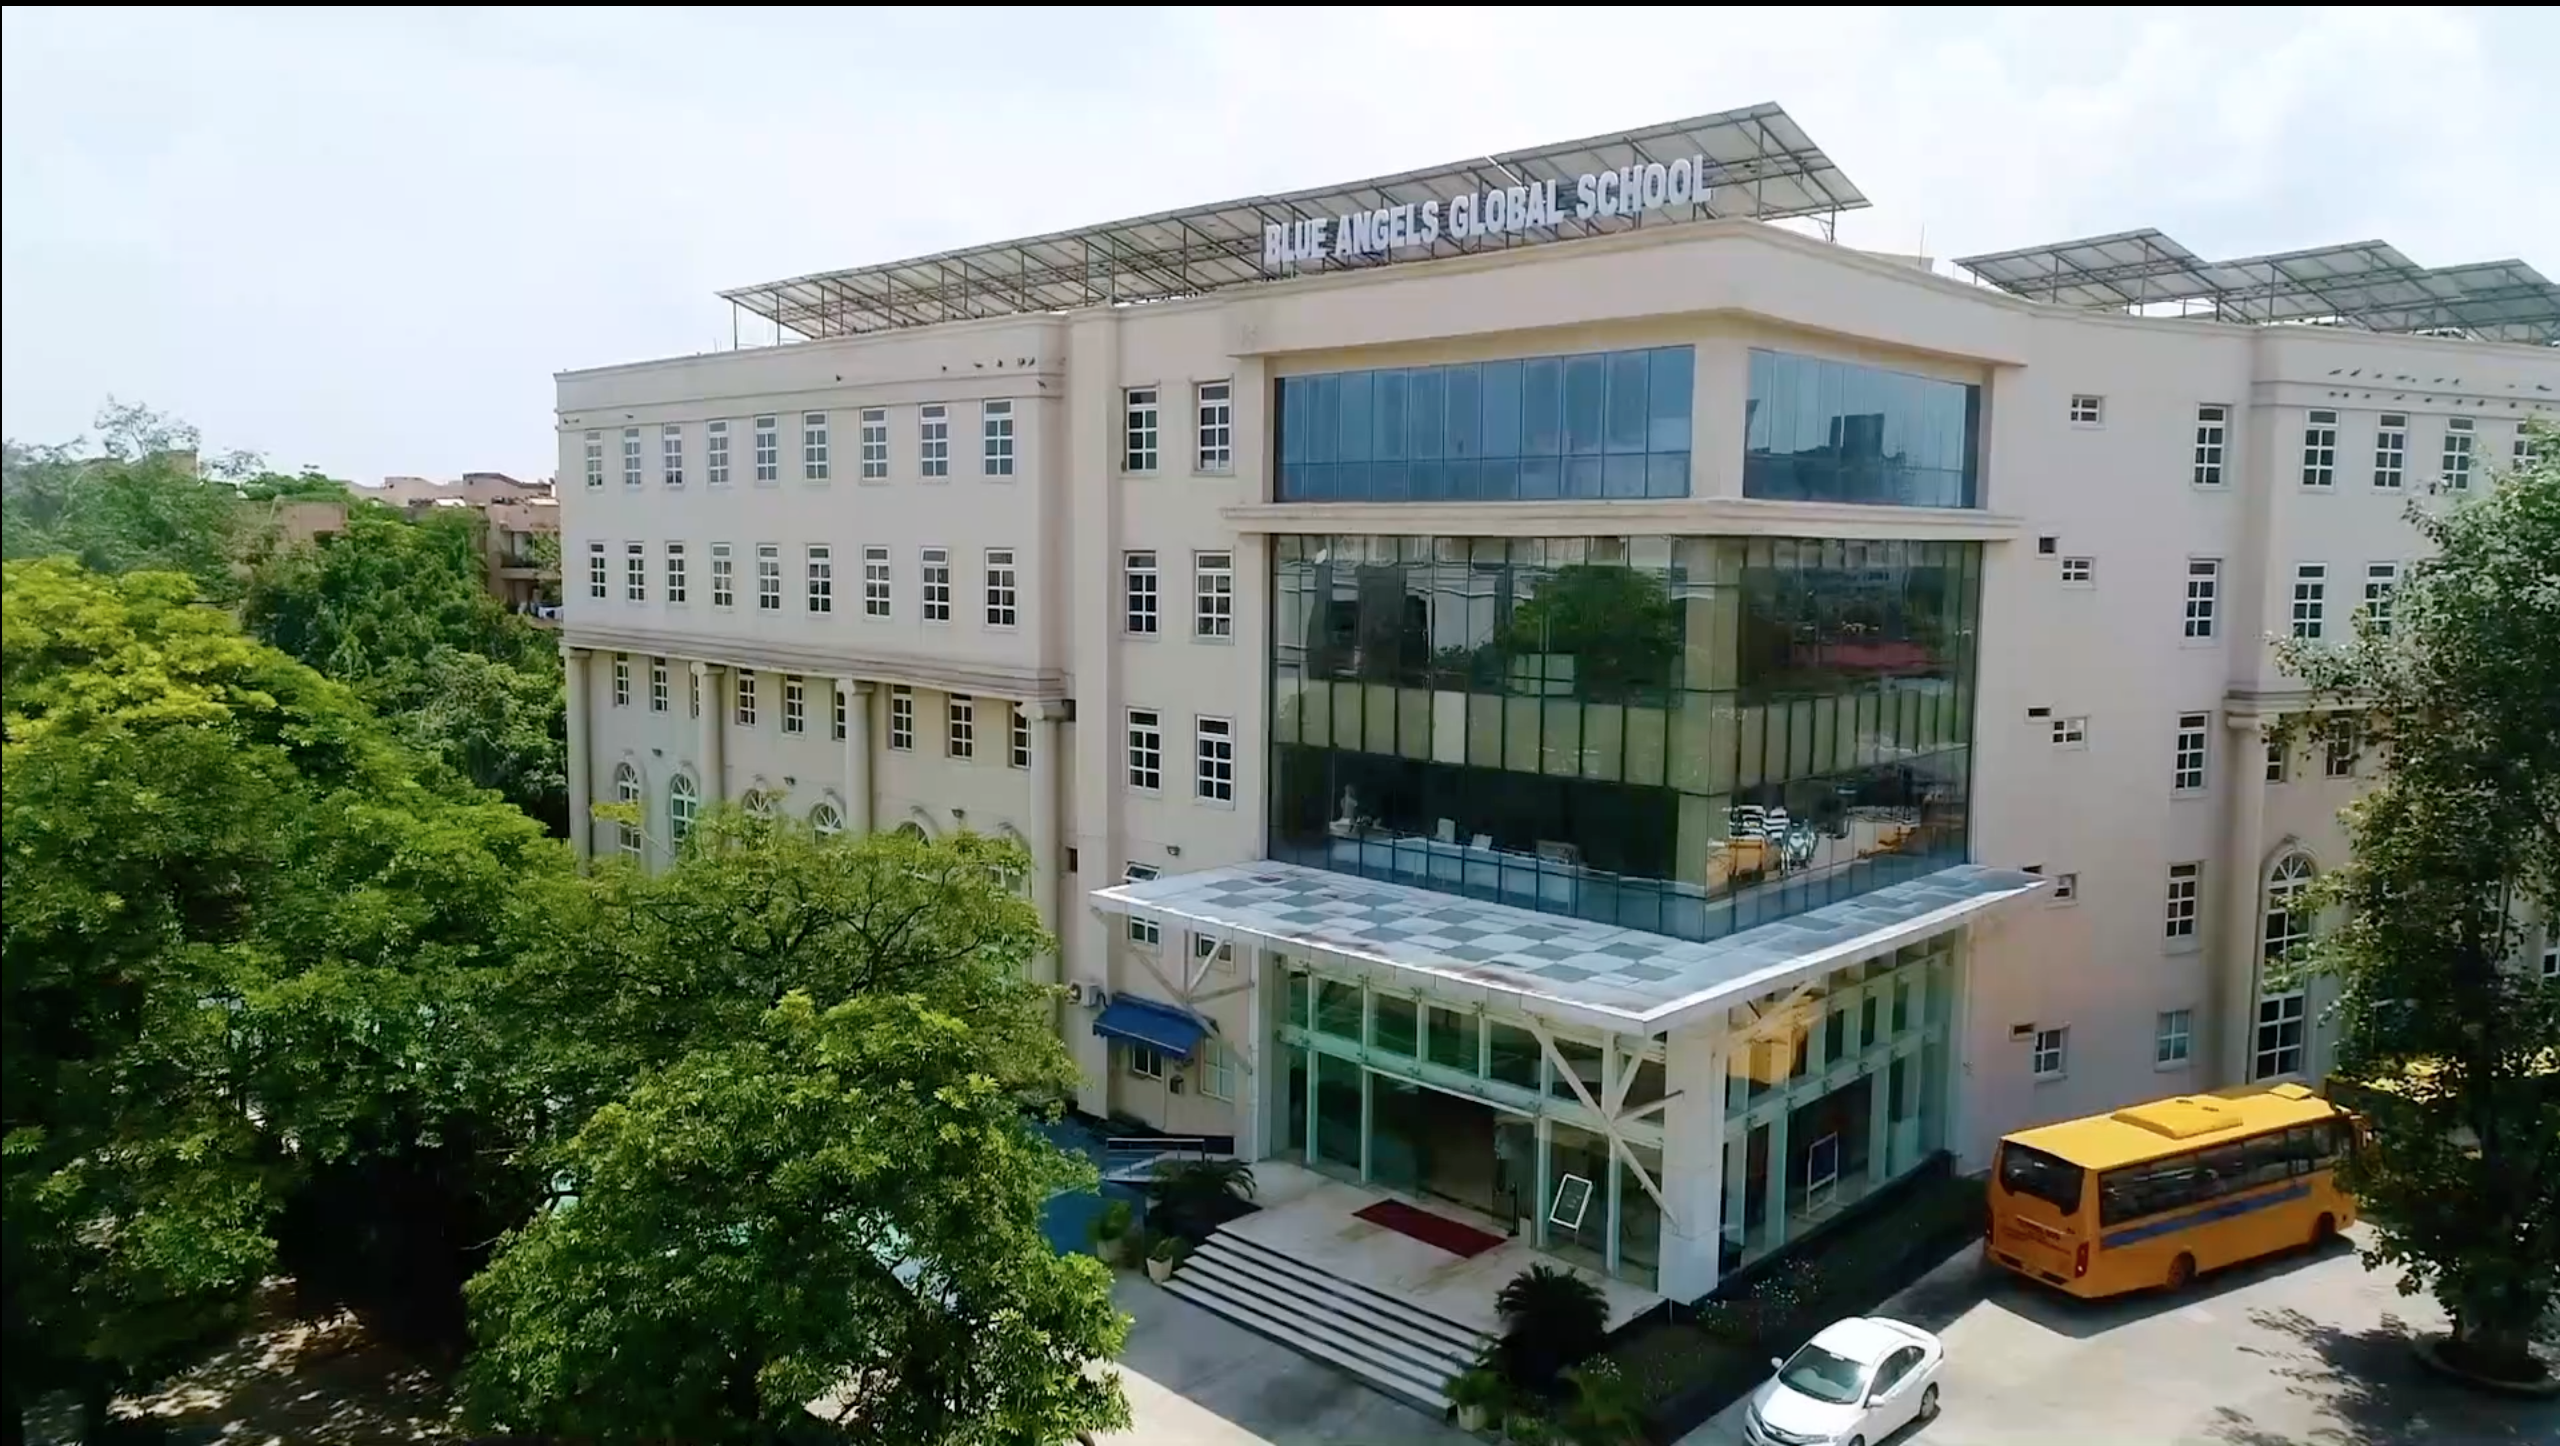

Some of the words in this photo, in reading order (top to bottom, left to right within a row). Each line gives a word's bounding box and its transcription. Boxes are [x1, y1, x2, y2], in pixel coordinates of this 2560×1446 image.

[1266, 217, 1328, 265] BLUE
[1335, 201, 1439, 258] ANGELS
[1450, 179, 1565, 239] GLOBAL
[1576, 154, 1711, 220] SCHOOL
